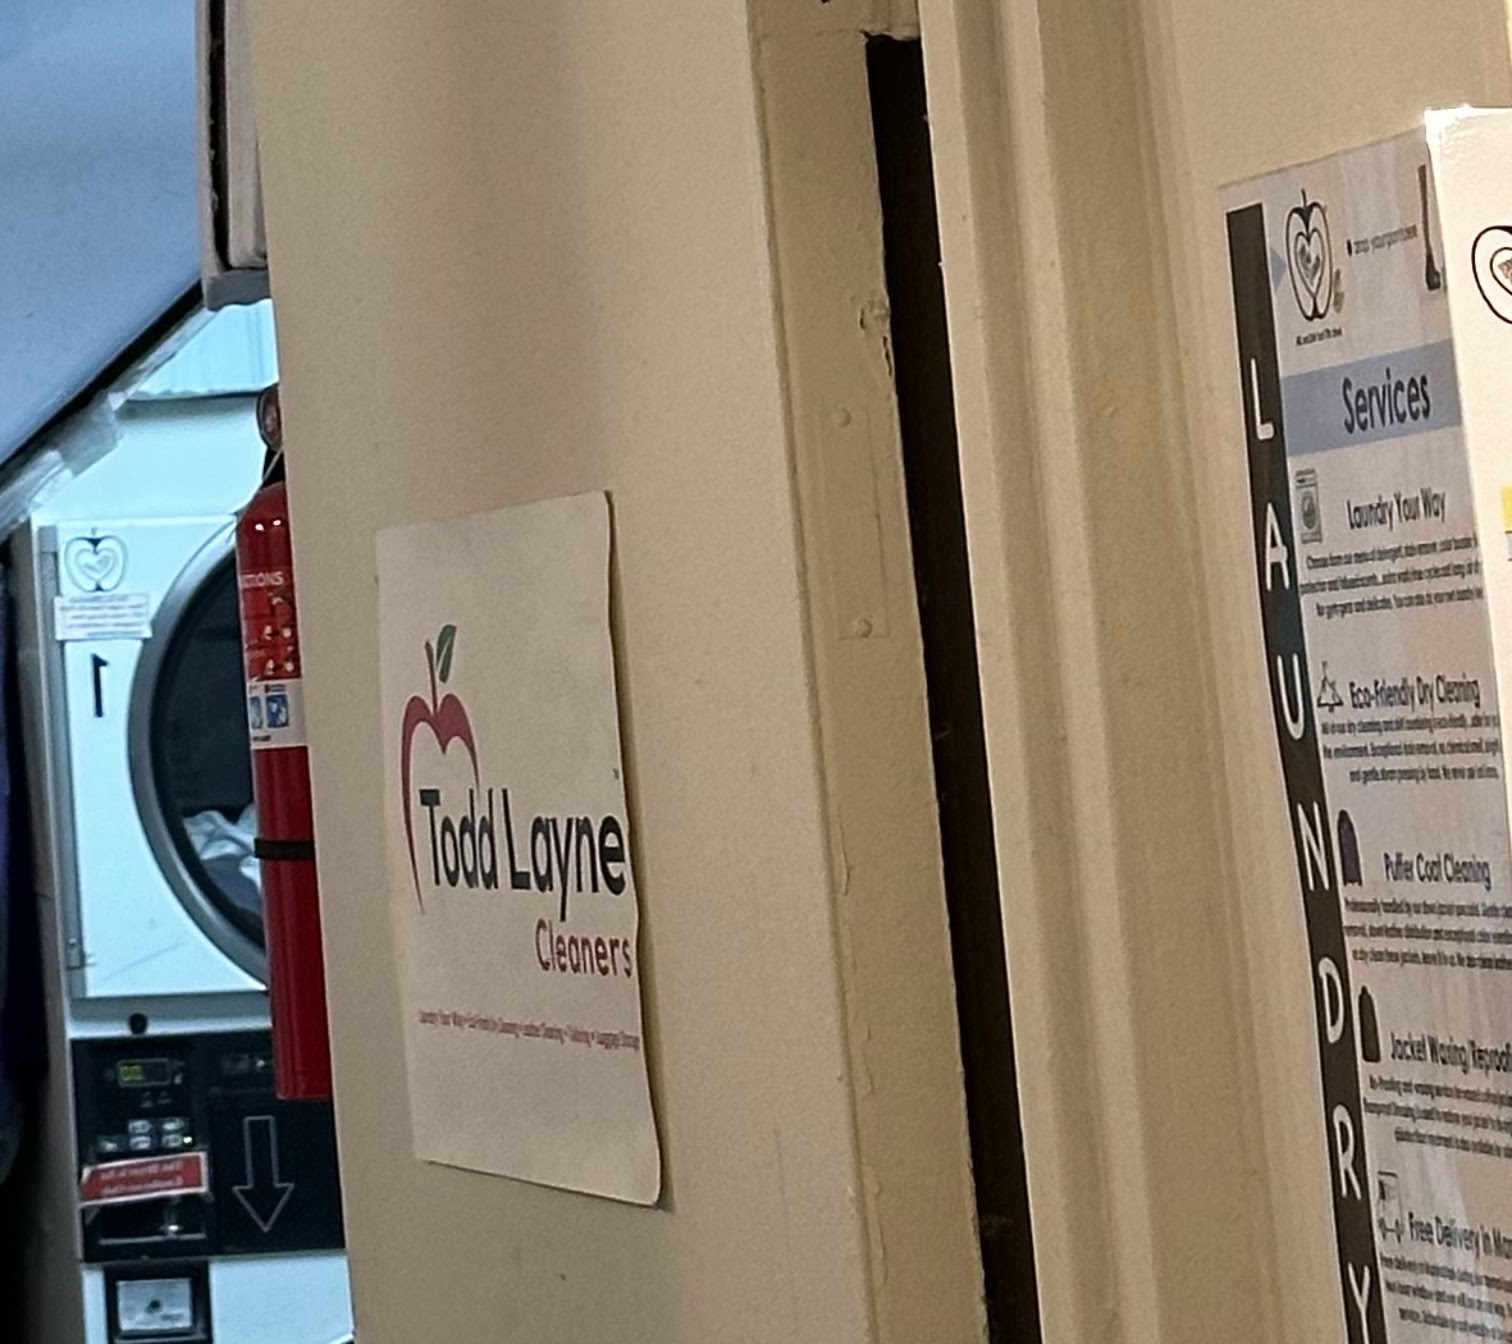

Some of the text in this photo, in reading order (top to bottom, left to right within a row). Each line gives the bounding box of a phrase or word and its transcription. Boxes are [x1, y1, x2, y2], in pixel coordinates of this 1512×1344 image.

[1341, 366, 1432, 435] Services
[1346, 486, 1447, 531] Laundry Your Way
[91, 653, 111, 718] 1
[1349, 676, 1415, 712] Eco-Friendly
[1436, 673, 1482, 709] Cleaning
[418, 787, 627, 923] Todd Layne
[1416, 852, 1441, 883] Coat
[1443, 852, 1492, 892] Cleaning
[534, 918, 632, 979] Cleaners
[1390, 1031, 1427, 1062] Jacket
[1408, 1211, 1434, 1245] Free
